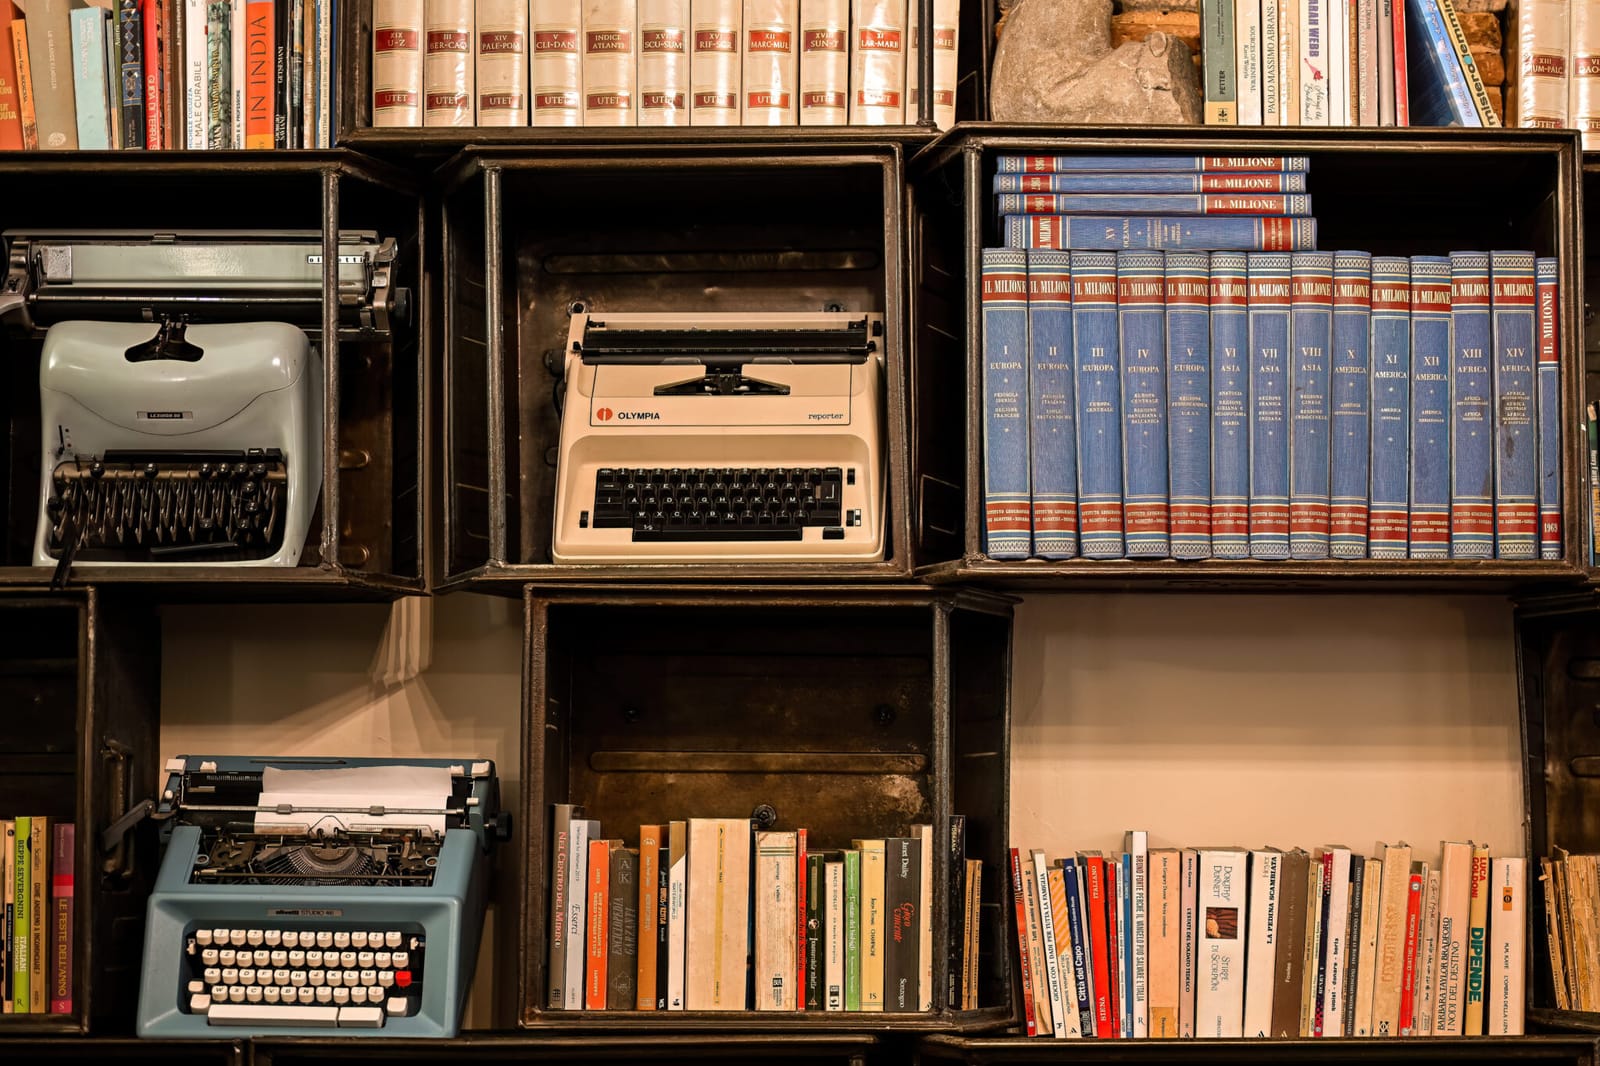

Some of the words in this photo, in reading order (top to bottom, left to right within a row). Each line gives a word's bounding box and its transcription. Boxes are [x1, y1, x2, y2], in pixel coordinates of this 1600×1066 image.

[1266, 6, 1275, 41] ABRANS
[250, 16, 266, 86] INDIA
[387, 39, 405, 47] U-Z
[536, 41, 576, 49] CLI-DAN
[751, 41, 790, 49] MARC-MUL
[1309, 28, 1319, 57] WEBB
[1250, 54, 1256, 62] OF
[1267, 43, 1275, 83] MASSIMO
[1539, 57, 1552, 65] XIII
[147, 75, 156, 100] GUIDA
[193, 60, 202, 109] CURABILE
[148, 102, 156, 112] DI
[385, 94, 408, 103] UTET
[489, 96, 514, 105] UTET
[1267, 85, 1275, 114] PAOLO
[250, 96, 266, 120] IN
[149, 115, 157, 143] TERRA
[194, 111, 203, 137] MALE
[1212, 158, 1223, 167] IL
[1228, 157, 1275, 167] MILIONE
[1210, 179, 1220, 188] IL
[1224, 179, 1273, 188] MILIONE
[1214, 200, 1225, 209] IL
[1229, 200, 1277, 209] MILIONE
[1120, 283, 1129, 296] IL
[1131, 283, 1163, 296] MILIONE
[1250, 283, 1257, 296] IL
[1259, 283, 1290, 296] MILIONE
[1293, 282, 1299, 296] IL
[1301, 282, 1331, 296] MILIONE
[1340, 284, 1370, 297] MILIONE
[1412, 290, 1419, 304] IL
[1420, 290, 1450, 304] MILIONE
[1494, 284, 1502, 297] IL
[1503, 284, 1533, 297] MILIONE
[1543, 291, 1552, 339] MILIONE
[1004, 345, 1008, 355] I
[1049, 347, 1057, 356] II
[1092, 347, 1104, 357] III
[1138, 349, 1150, 358] IV
[1186, 348, 1193, 357] V
[1225, 348, 1236, 358] VI
[1262, 349, 1277, 358] VII
[1302, 347, 1321, 357] VIII
[1348, 350, 1355, 359] X
[1462, 348, 1482, 358] XIII
[1506, 348, 1524, 358] XIV
[1543, 345, 1552, 354] IL
[1037, 363, 1069, 371] EUROPA
[1221, 364, 1240, 372] ASIA
[1301, 364, 1322, 372] ASIA
[1385, 355, 1397, 364] XI
[618, 412, 660, 420] OLYMPIA
[808, 412, 844, 421] reporter
[558, 832, 567, 851] NEL
[901, 841, 909, 857] Janet
[557, 852, 567, 891] CENTRO
[901, 858, 910, 879] Dailey
[1136, 855, 1144, 874] BRUNO
[1479, 857, 1487, 881] LUCA
[1136, 875, 1144, 892] FORTE
[1213, 865, 1222, 898] DUNNETT
[1221, 866, 1233, 902] DOROTHY
[1269, 856, 1277, 901] SCAMBIATA
[1472, 857, 1480, 898] GOLDONI
[17, 866, 25, 919] SEVERGNINI
[1039, 872, 1048, 901] FAMIGLIA
[59, 898, 68, 910] LE
[556, 892, 564, 909] DEL
[1043, 901, 1049, 910] LA
[902, 903, 914, 927] Gioco
[59, 912, 68, 941] FESTE
[611, 897, 623, 955] ENCICLOPEDIA
[625, 907, 635, 955] GARZANTI
[1136, 920, 1144, 943] VANGELO
[1267, 933, 1273, 944] LA
[1440, 917, 1451, 961] BRADFORD
[1073, 945, 1084, 967] Capo
[1449, 941, 1459, 982] DESTINO
[58, 944, 68, 996] DELL'ANNO
[1076, 967, 1084, 980] del
[1136, 957, 1144, 980] SALVARE
[1439, 962, 1448, 991] TAYLOR
[899, 978, 907, 1009] Sonzogno
[1051, 980, 1060, 1002] GIOCHI
[1077, 981, 1087, 1001] Città
[1136, 981, 1144, 1002] L'ITALIA
[1449, 984, 1457, 1001] DEL
[1099, 996, 1107, 1022] SIENA
[1437, 993, 1446, 1031] BARBARA
[1448, 1003, 1456, 1026] NODI
